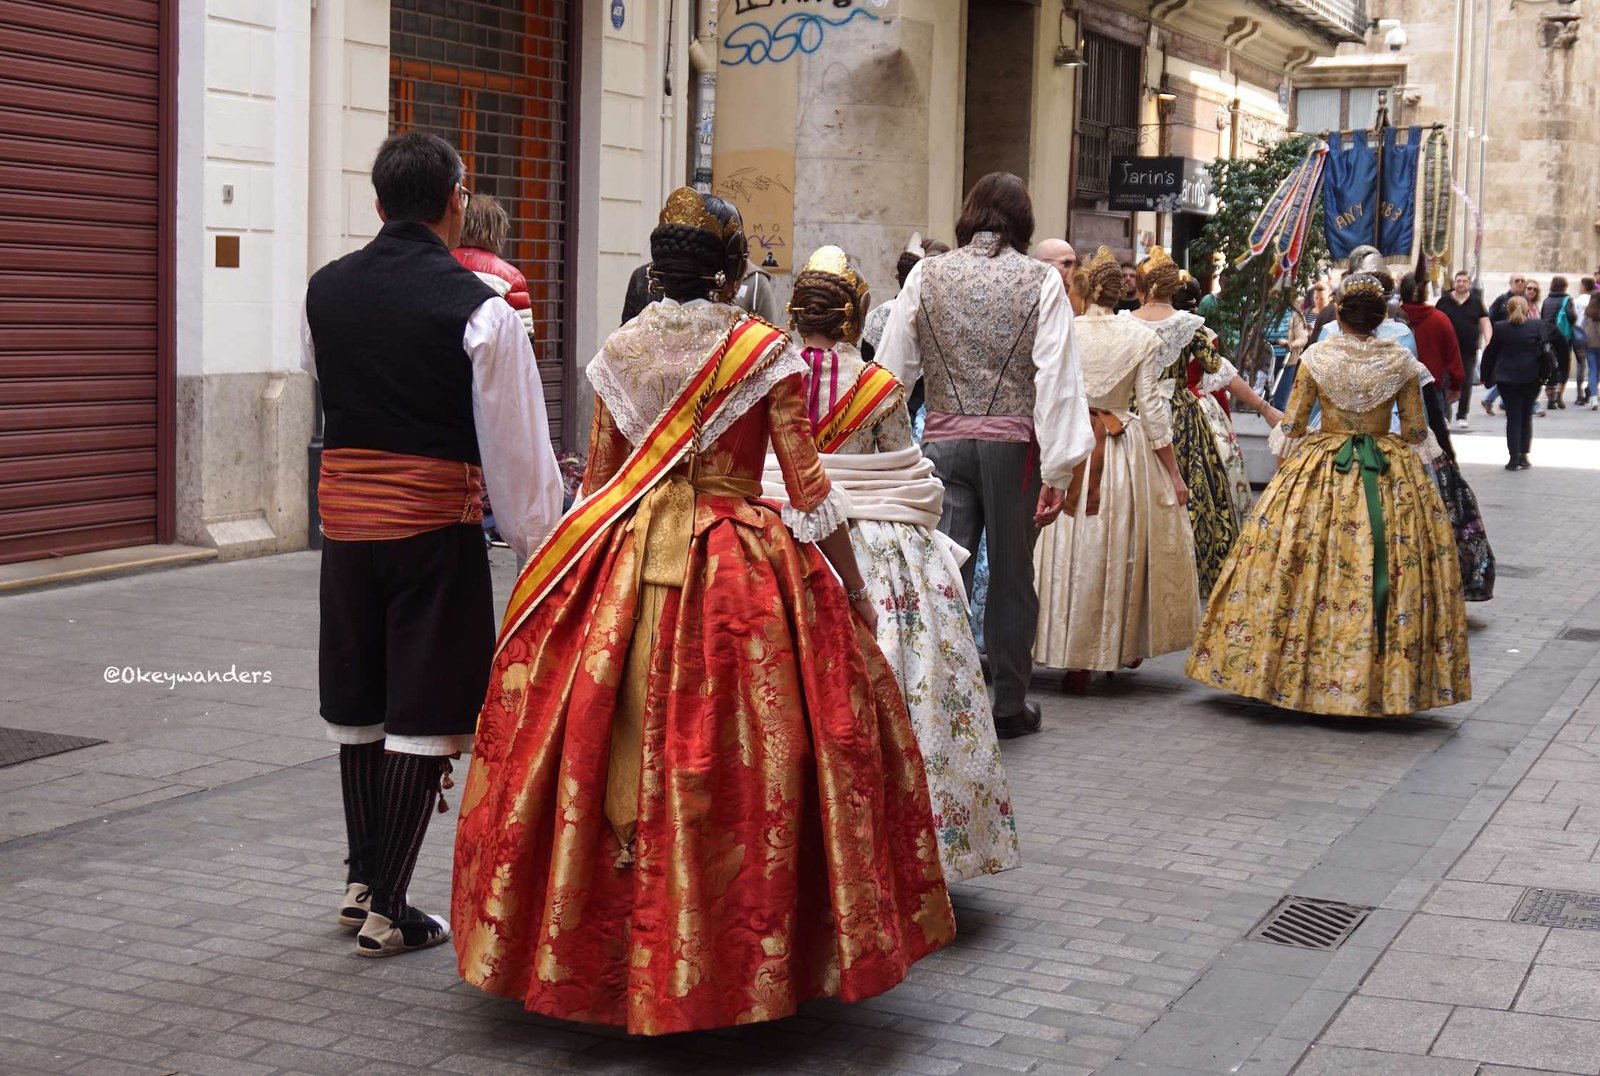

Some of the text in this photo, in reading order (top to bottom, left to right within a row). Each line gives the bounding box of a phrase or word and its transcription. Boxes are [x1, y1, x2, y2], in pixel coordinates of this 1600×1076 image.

[1121, 161, 1175, 185] Tarin's
[1182, 176, 1205, 207] arin's
[1336, 202, 1363, 230] ANY
